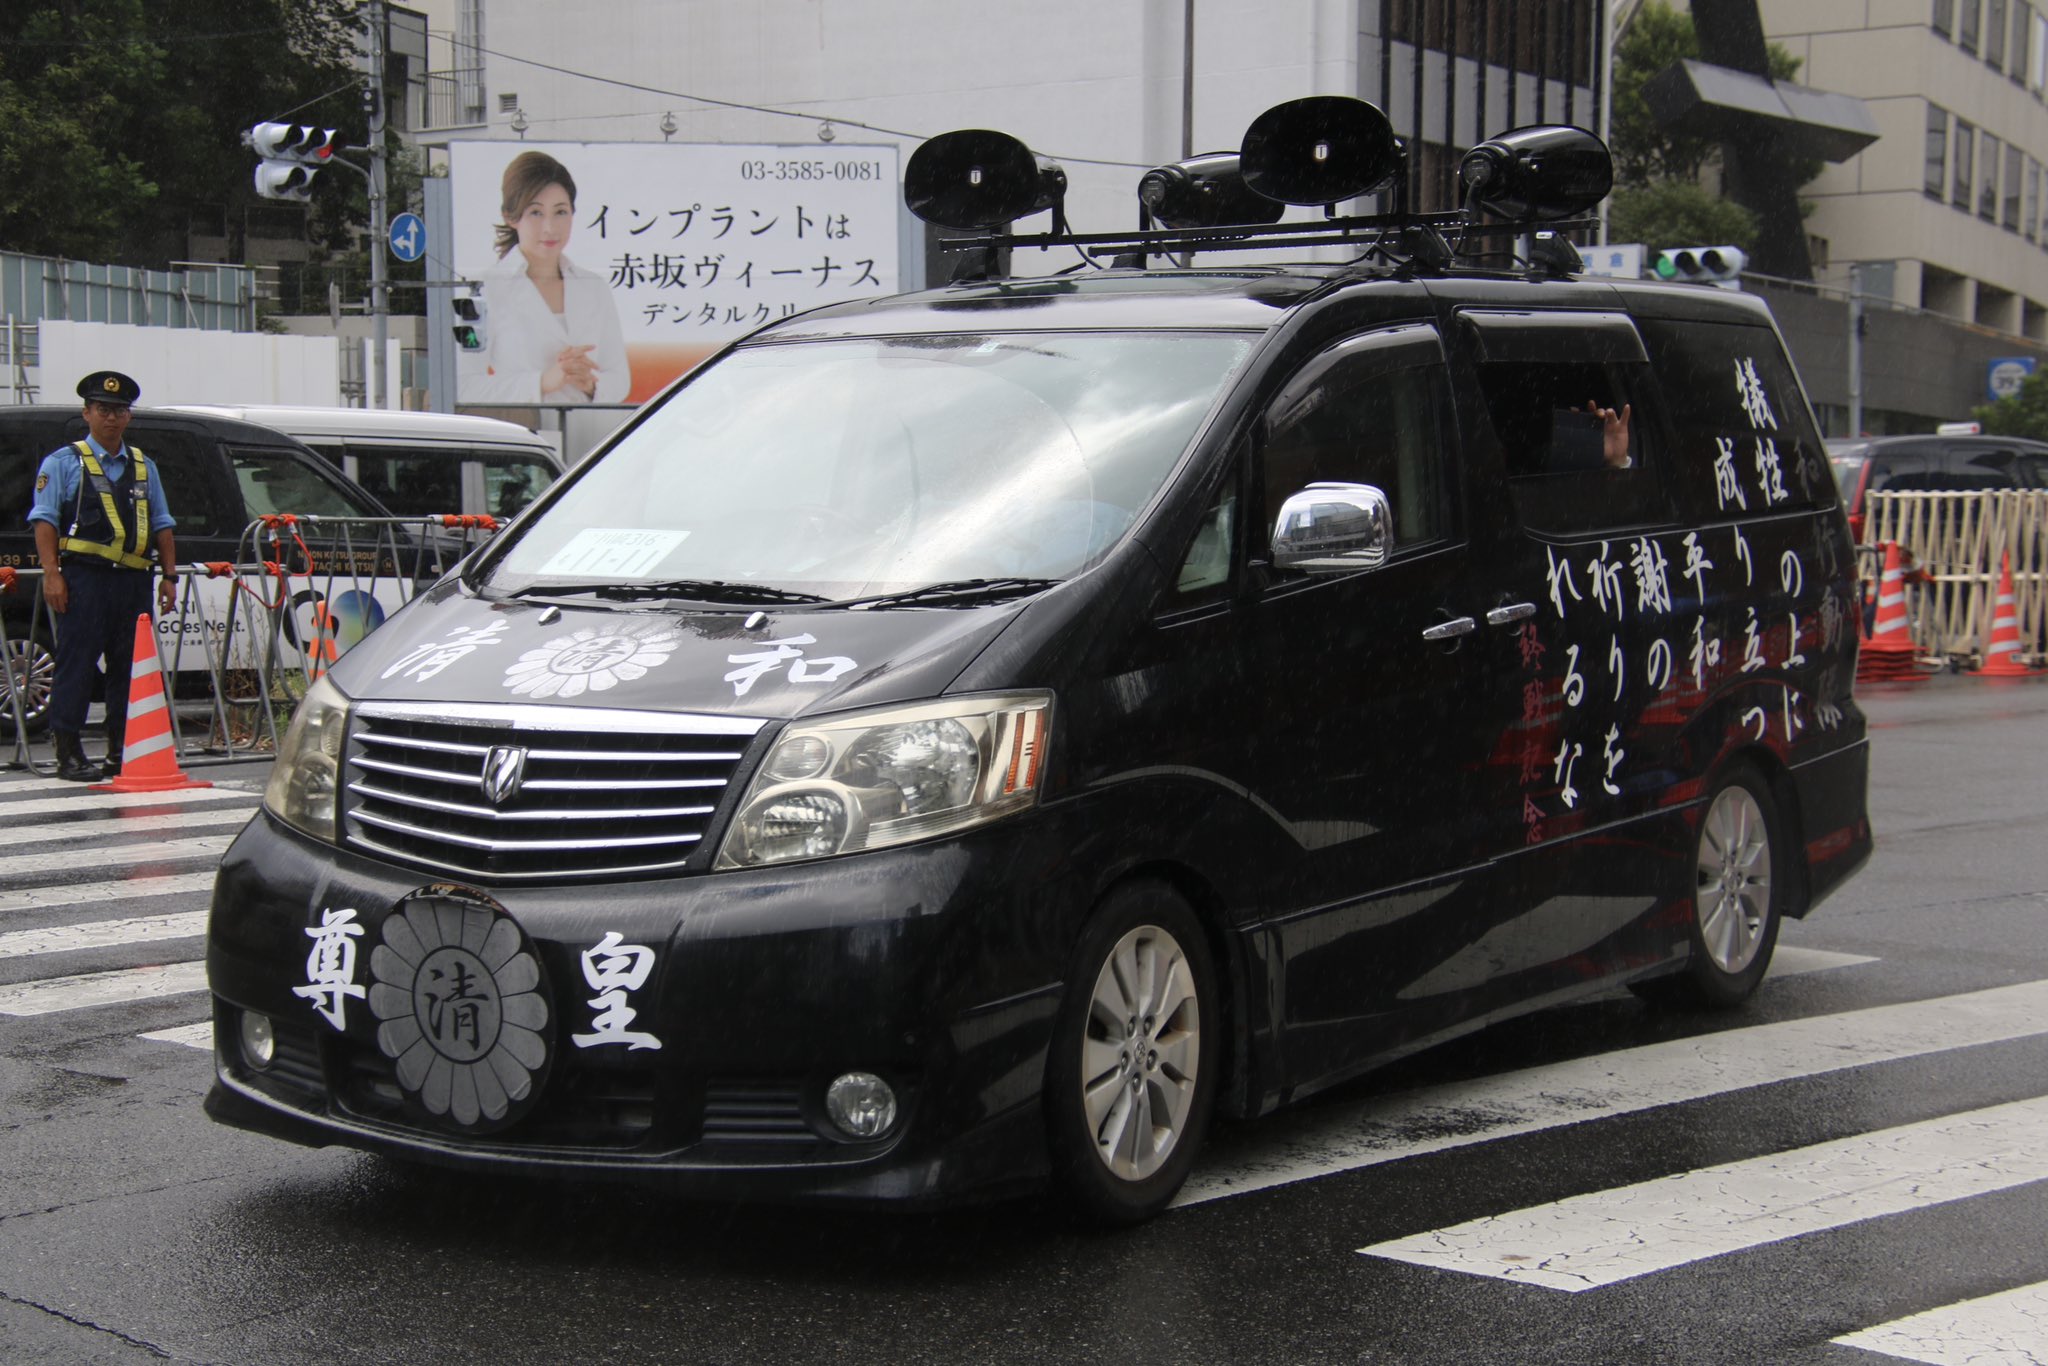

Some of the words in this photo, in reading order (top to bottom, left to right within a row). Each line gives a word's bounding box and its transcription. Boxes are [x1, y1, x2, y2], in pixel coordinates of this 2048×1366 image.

[741, 161, 882, 181] 03-3585-0081
[586, 203, 850, 241] インプラントは
[608, 253, 881, 291] 赤坂ヴィーナス
[0, 555, 20, 565] 39
[205, 620, 245, 633] Net.
[725, 633, 858, 697] 和
[1547, 545, 1583, 809] れるな
[292, 907, 366, 1032] 尊
[571, 931, 662, 1051] 皇
[423, 961, 490, 1052] 清
